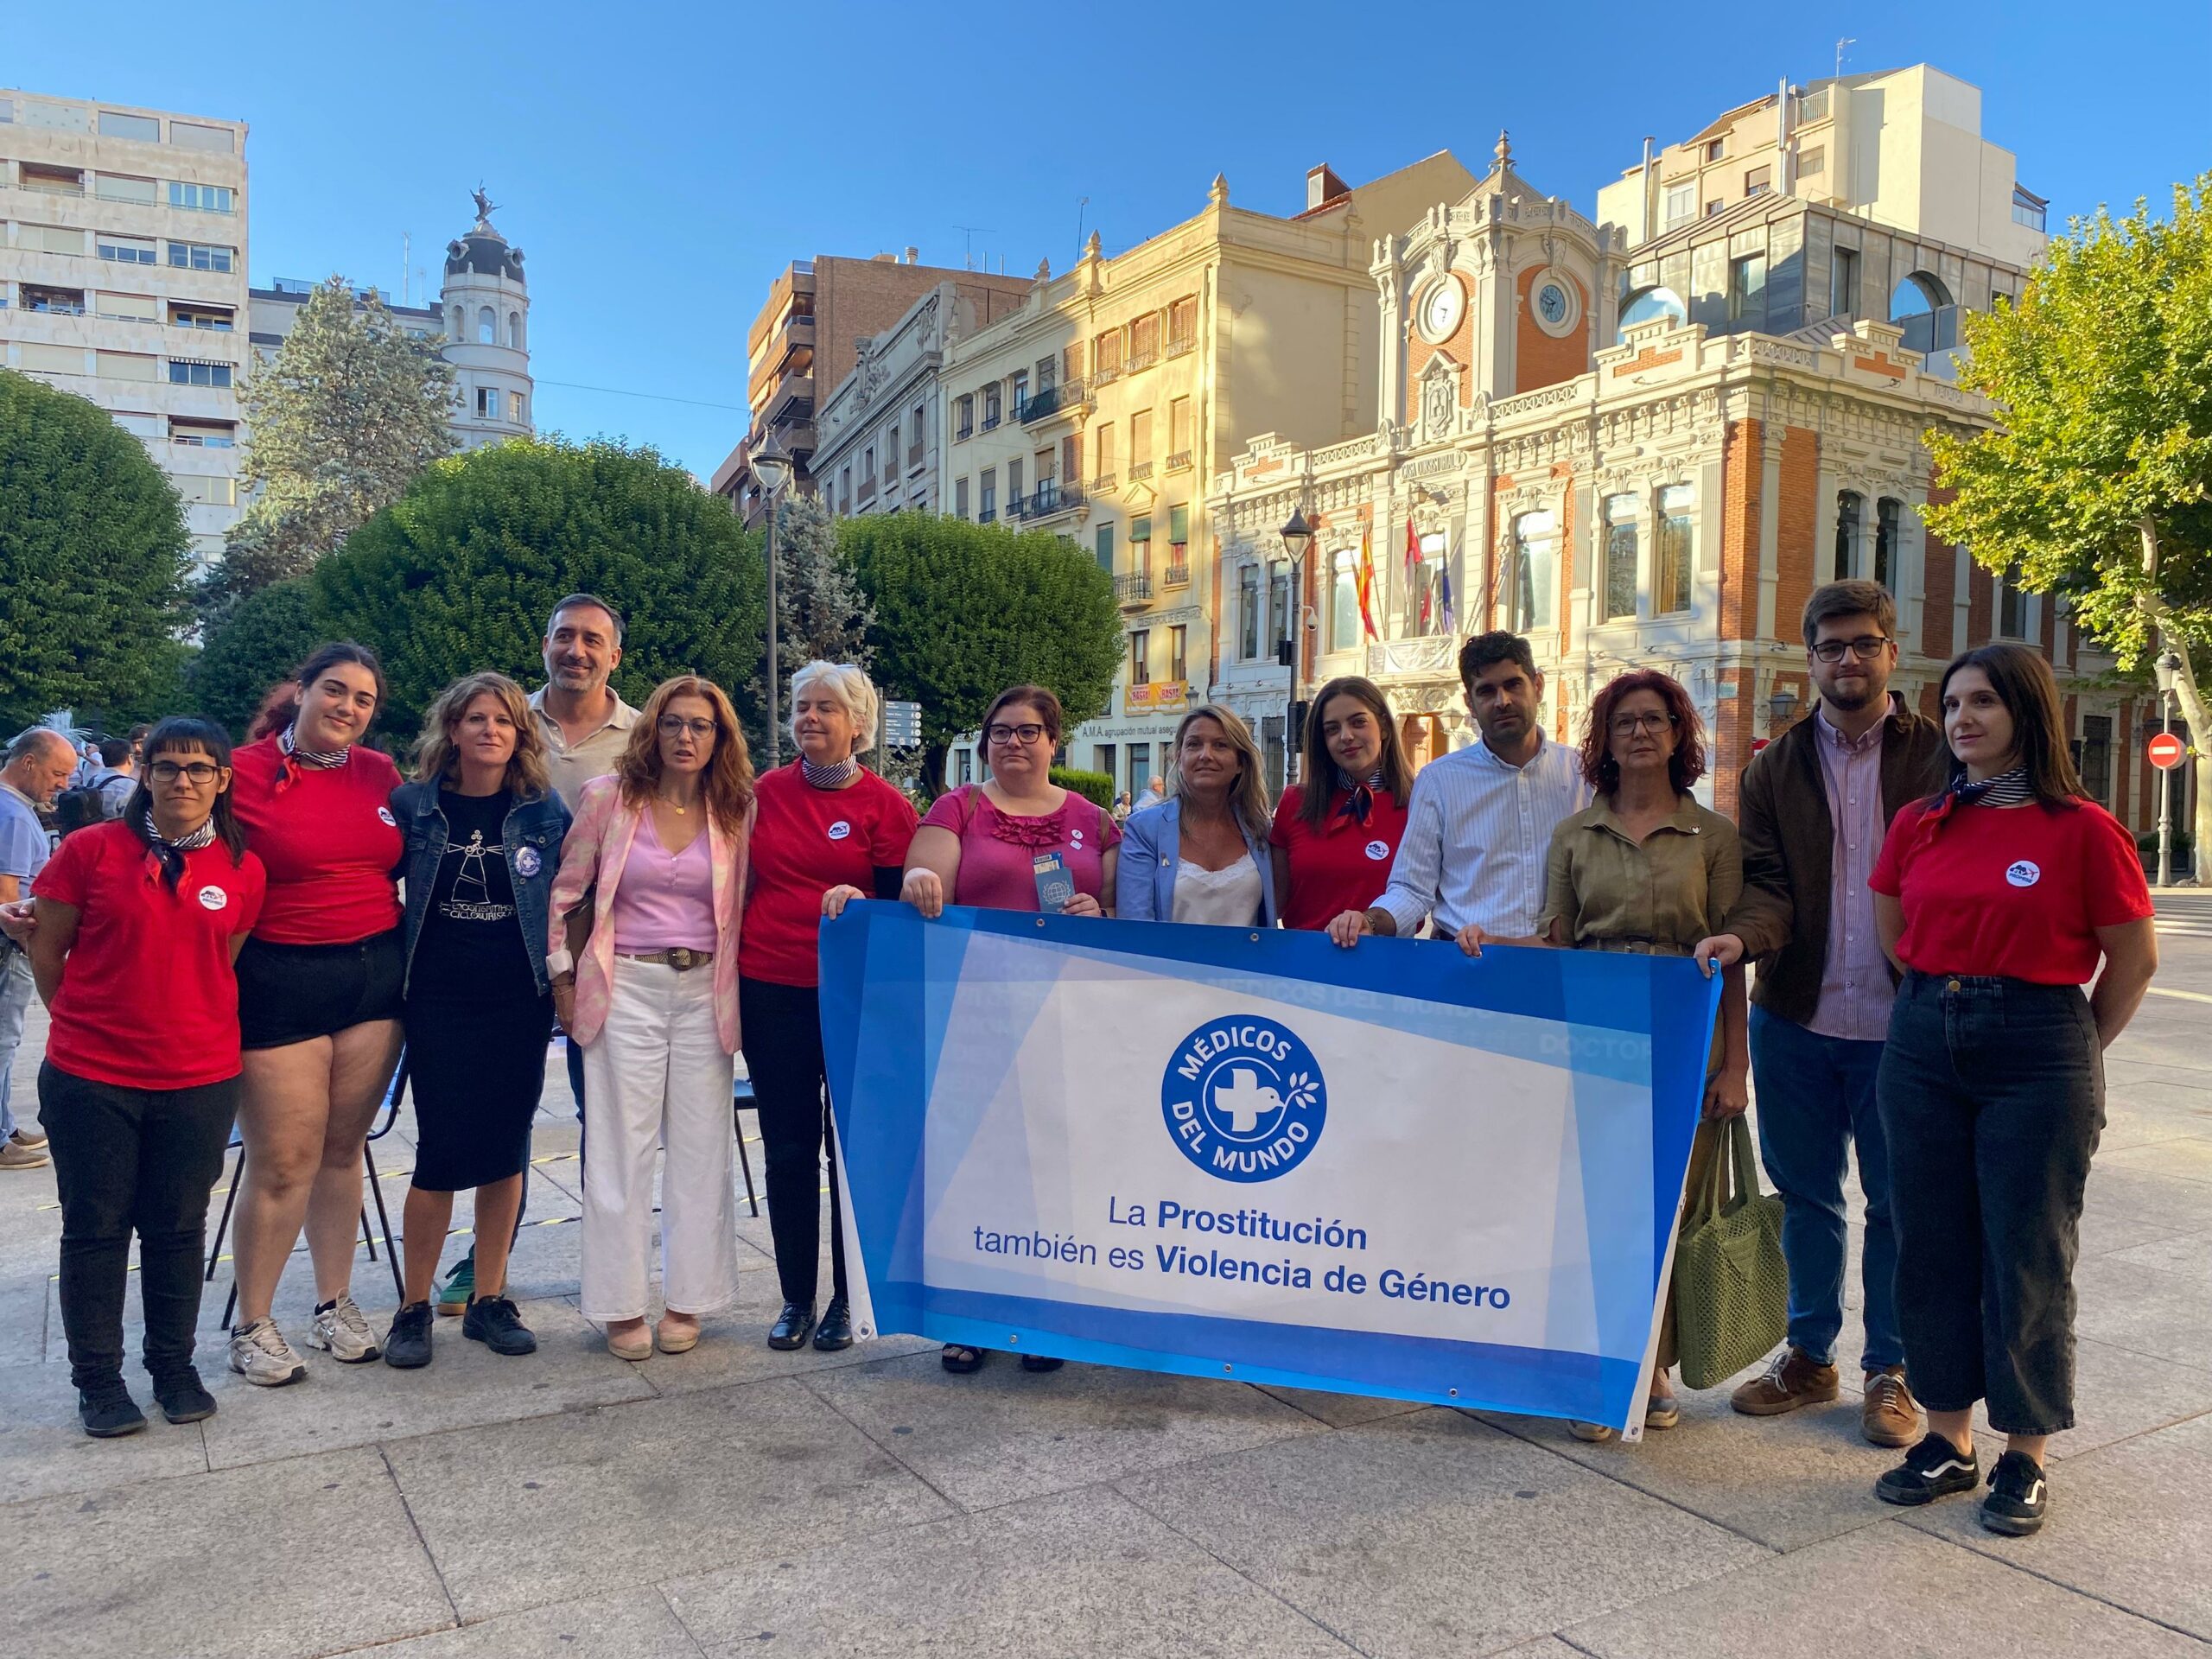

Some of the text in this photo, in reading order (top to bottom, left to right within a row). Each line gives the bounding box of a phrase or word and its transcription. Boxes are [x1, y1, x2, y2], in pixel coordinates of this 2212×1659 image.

[1402, 462, 1417, 479] CASA
[1083, 726, 1103, 737] A.M.A.
[1105, 726, 1136, 738] agrupación
[1137, 726, 1157, 735] mutual
[1177, 1026, 1292, 1081] MÉDICOS
[1172, 1100, 1309, 1173] DEL MUNDO
[1109, 1196, 1367, 1250] La Prostitución
[974, 1225, 1510, 1309] también es Violencia de Género
